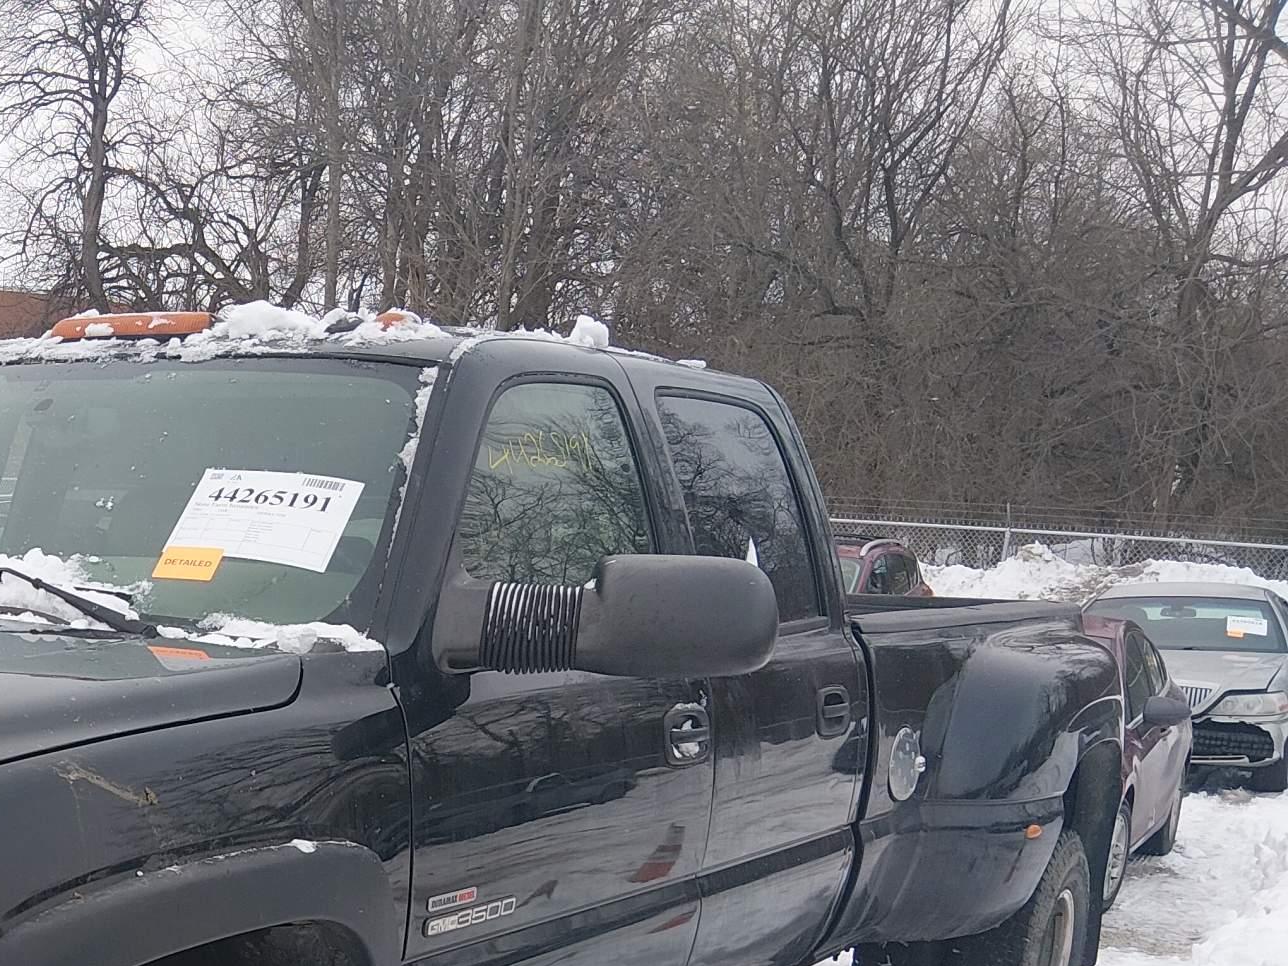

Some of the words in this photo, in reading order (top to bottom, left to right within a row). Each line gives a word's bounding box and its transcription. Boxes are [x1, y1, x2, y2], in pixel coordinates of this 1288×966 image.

[208, 486, 333, 512] 44265191
[164, 557, 213, 568] DETAILED
[456, 897, 516, 928] 3500
